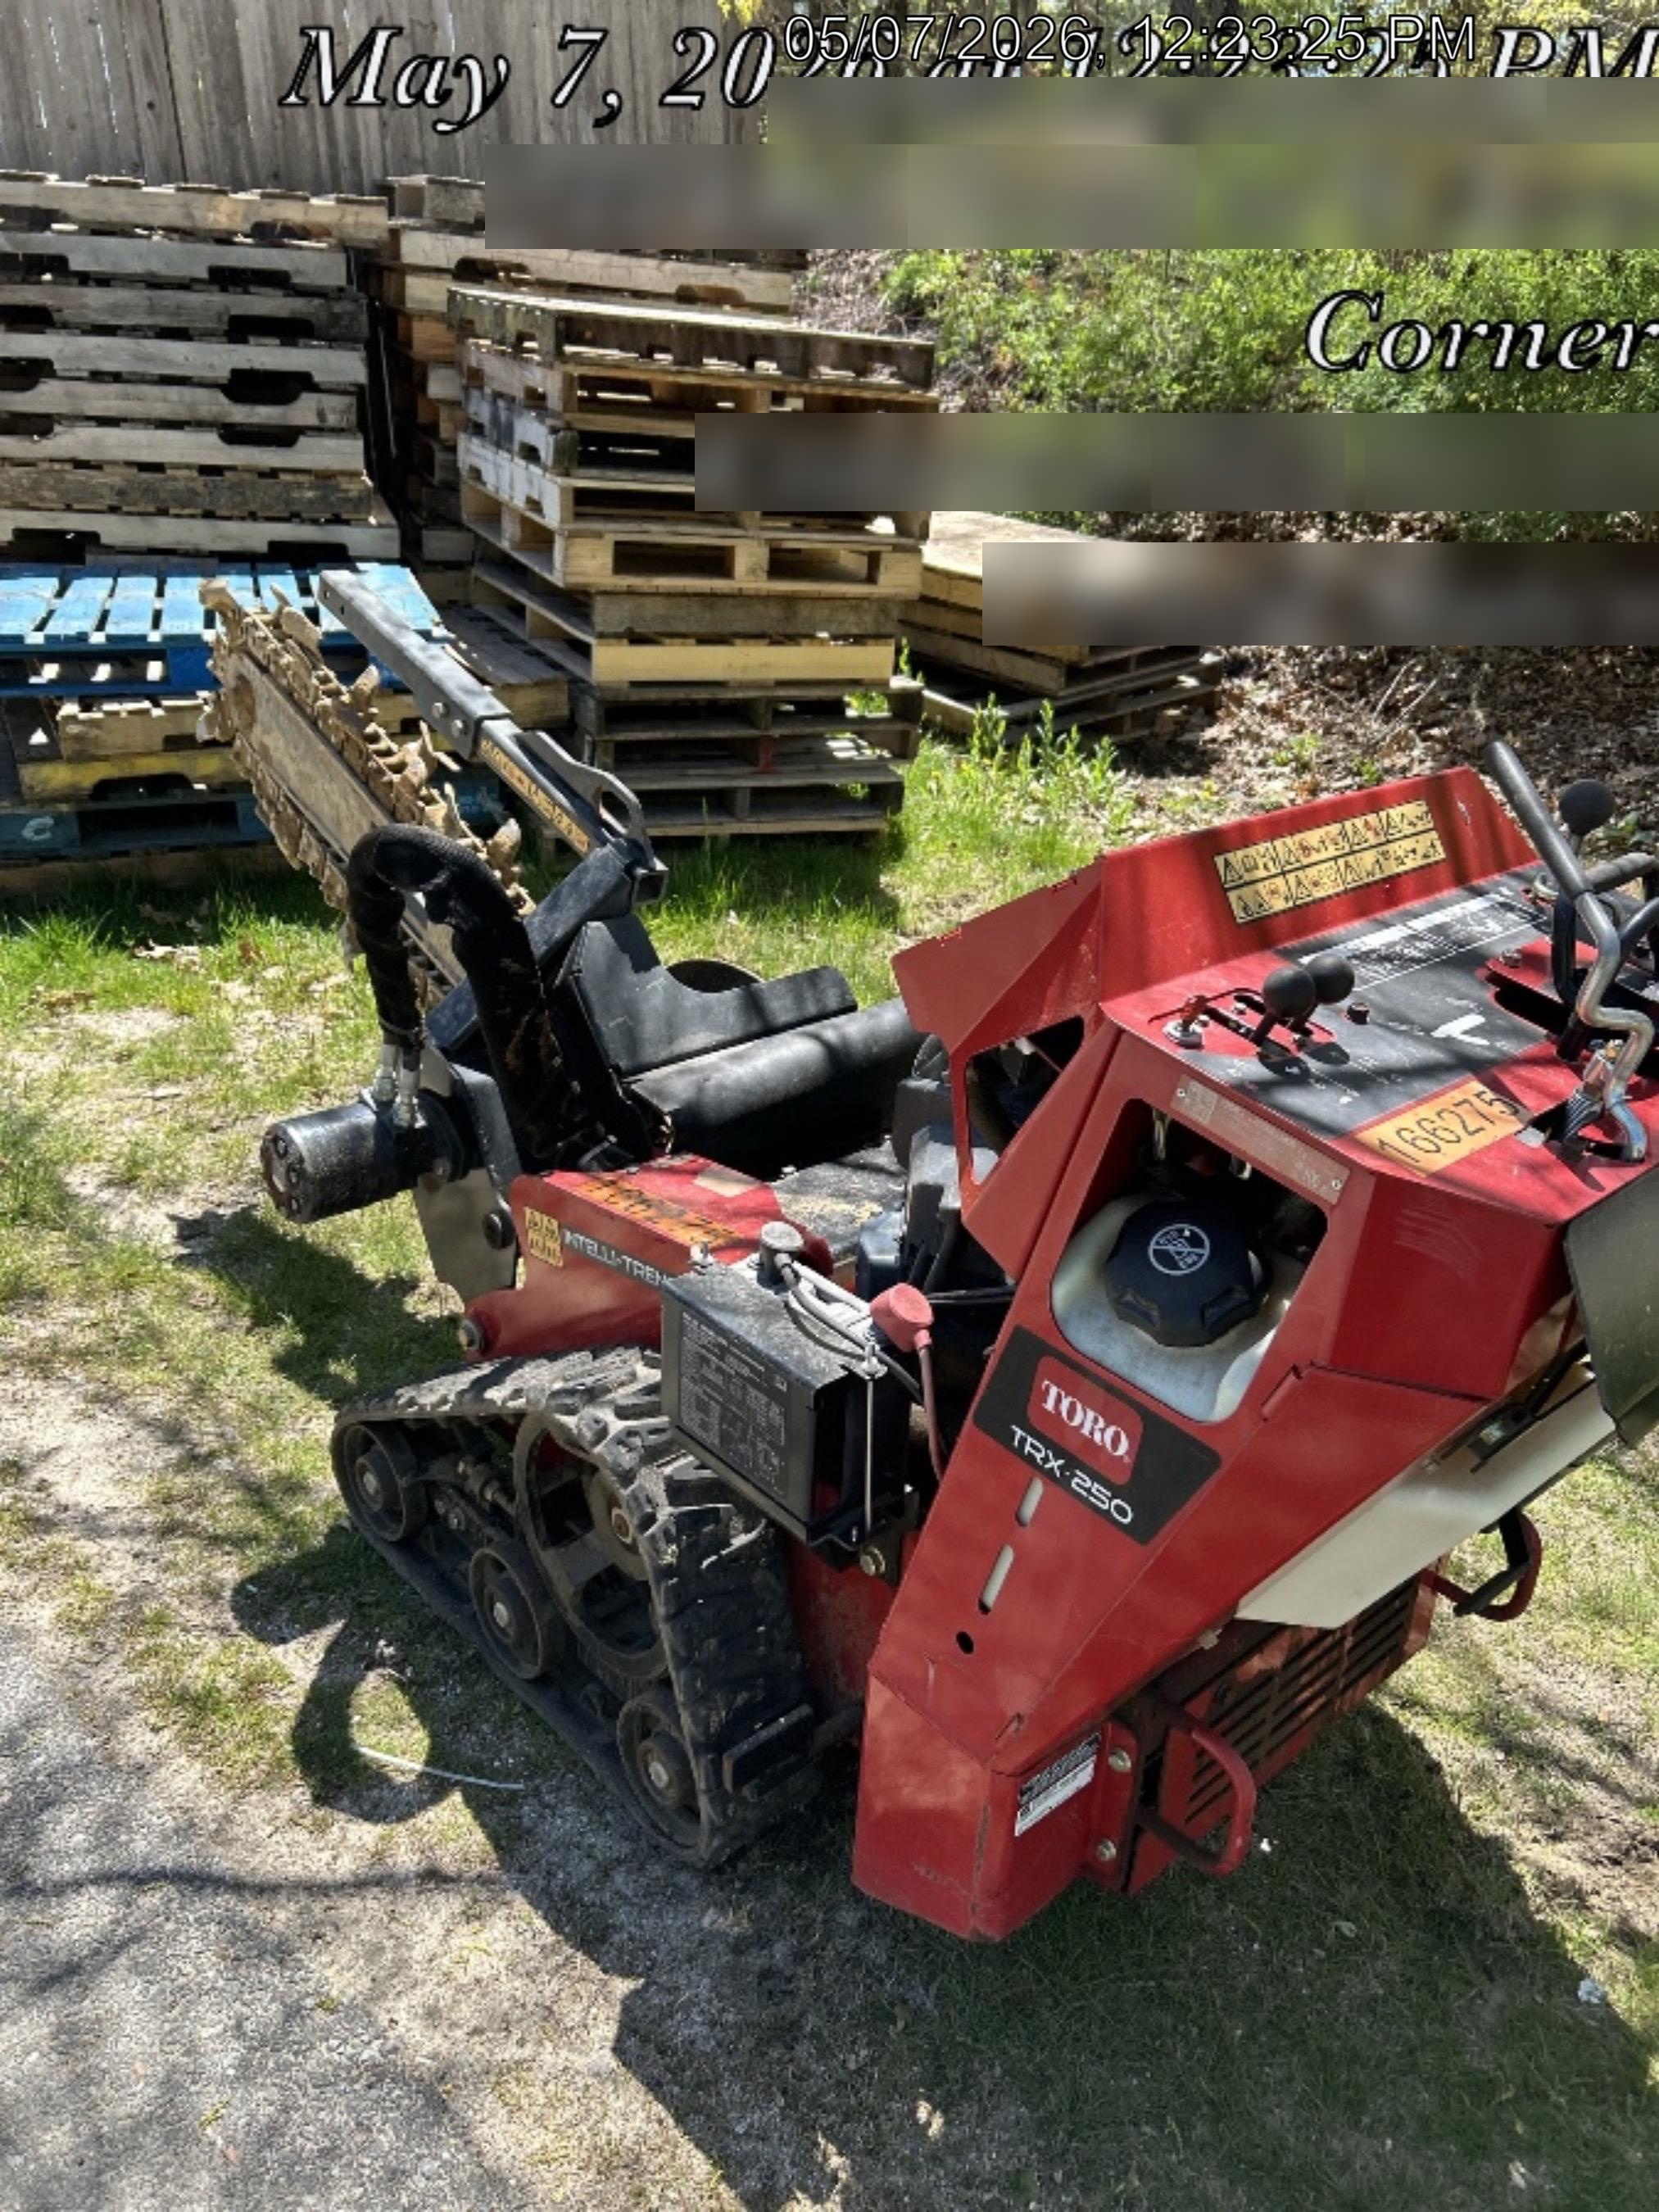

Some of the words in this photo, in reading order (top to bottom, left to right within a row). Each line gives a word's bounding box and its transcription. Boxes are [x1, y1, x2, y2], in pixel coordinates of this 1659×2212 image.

[1376, 1089, 1521, 1164] 166275
[1040, 1377, 1131, 1457] TORO
[1009, 1424, 1135, 1525] TRX-250
